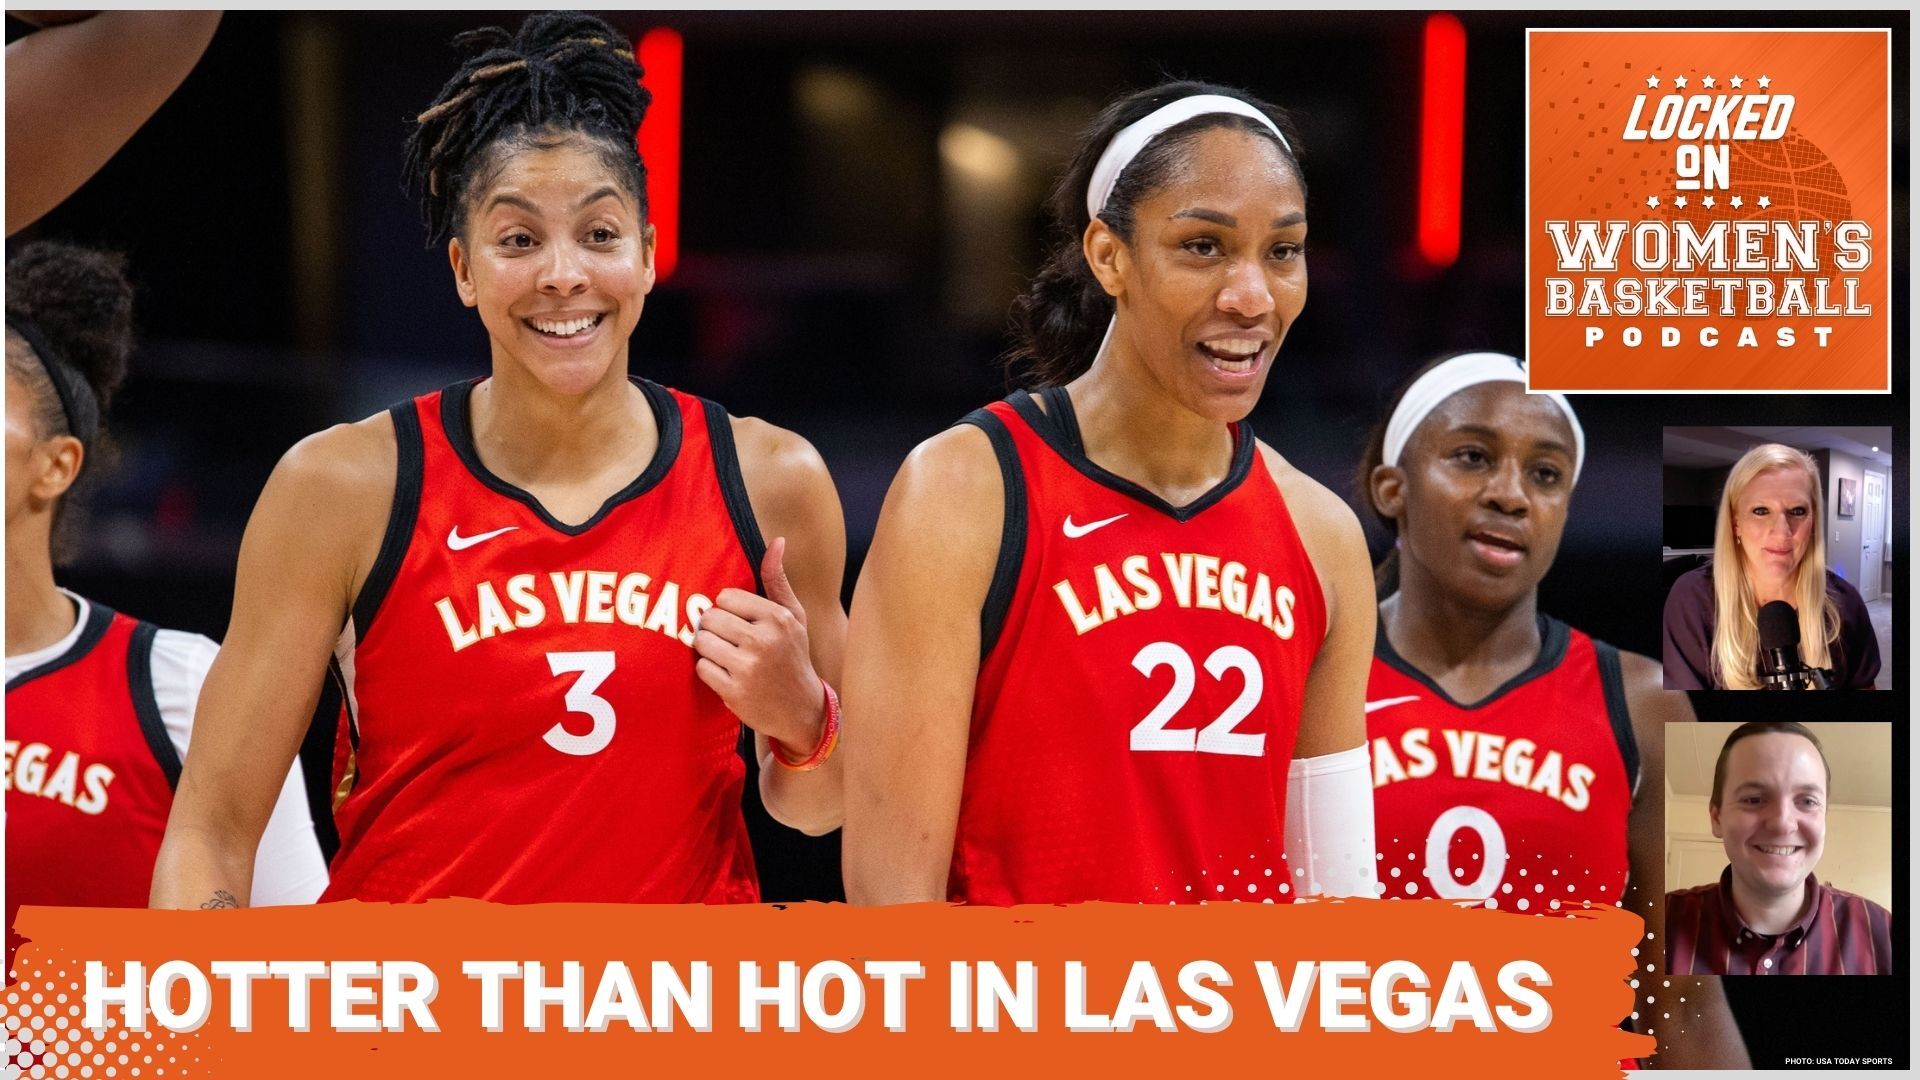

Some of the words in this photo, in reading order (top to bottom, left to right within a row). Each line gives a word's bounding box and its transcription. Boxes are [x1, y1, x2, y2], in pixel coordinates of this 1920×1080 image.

[434, 573, 546, 652] LAS
[549, 569, 713, 648] VEGAS
[1053, 554, 1162, 636] LAS
[1161, 552, 1296, 640] VEGAS
[542, 650, 617, 756] 3
[1130, 641, 1266, 757] 22
[1372, 727, 1439, 789] AS
[1441, 729, 1596, 812] VEGAS
